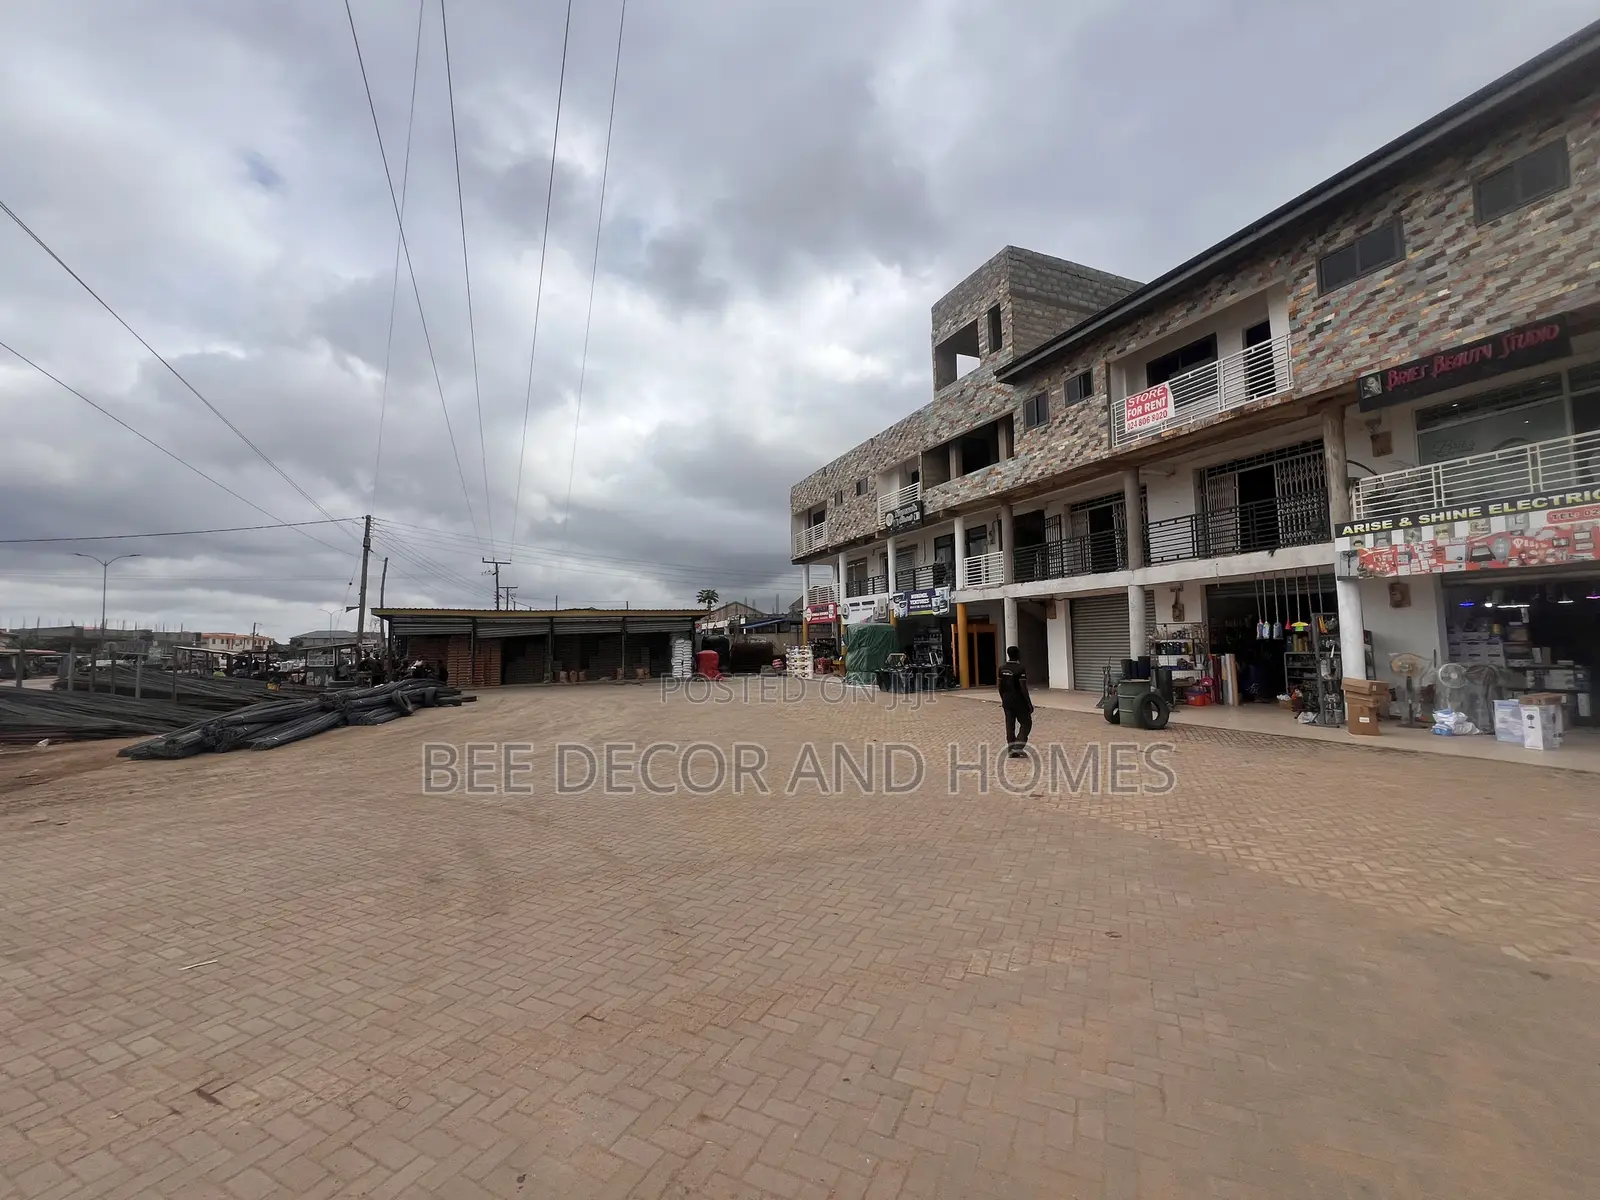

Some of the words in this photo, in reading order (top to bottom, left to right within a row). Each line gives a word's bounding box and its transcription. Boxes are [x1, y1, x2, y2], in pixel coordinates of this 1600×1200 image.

[1431, 344, 1492, 377] BEAUTY
[1498, 324, 1560, 359] STUDIO
[1128, 387, 1165, 407] STORE
[1128, 405, 1142, 419] FOR
[1145, 397, 1166, 412] RENT
[1342, 519, 1393, 535] ARISE
[1398, 516, 1413, 527] &
[1418, 507, 1482, 524] SHINE
